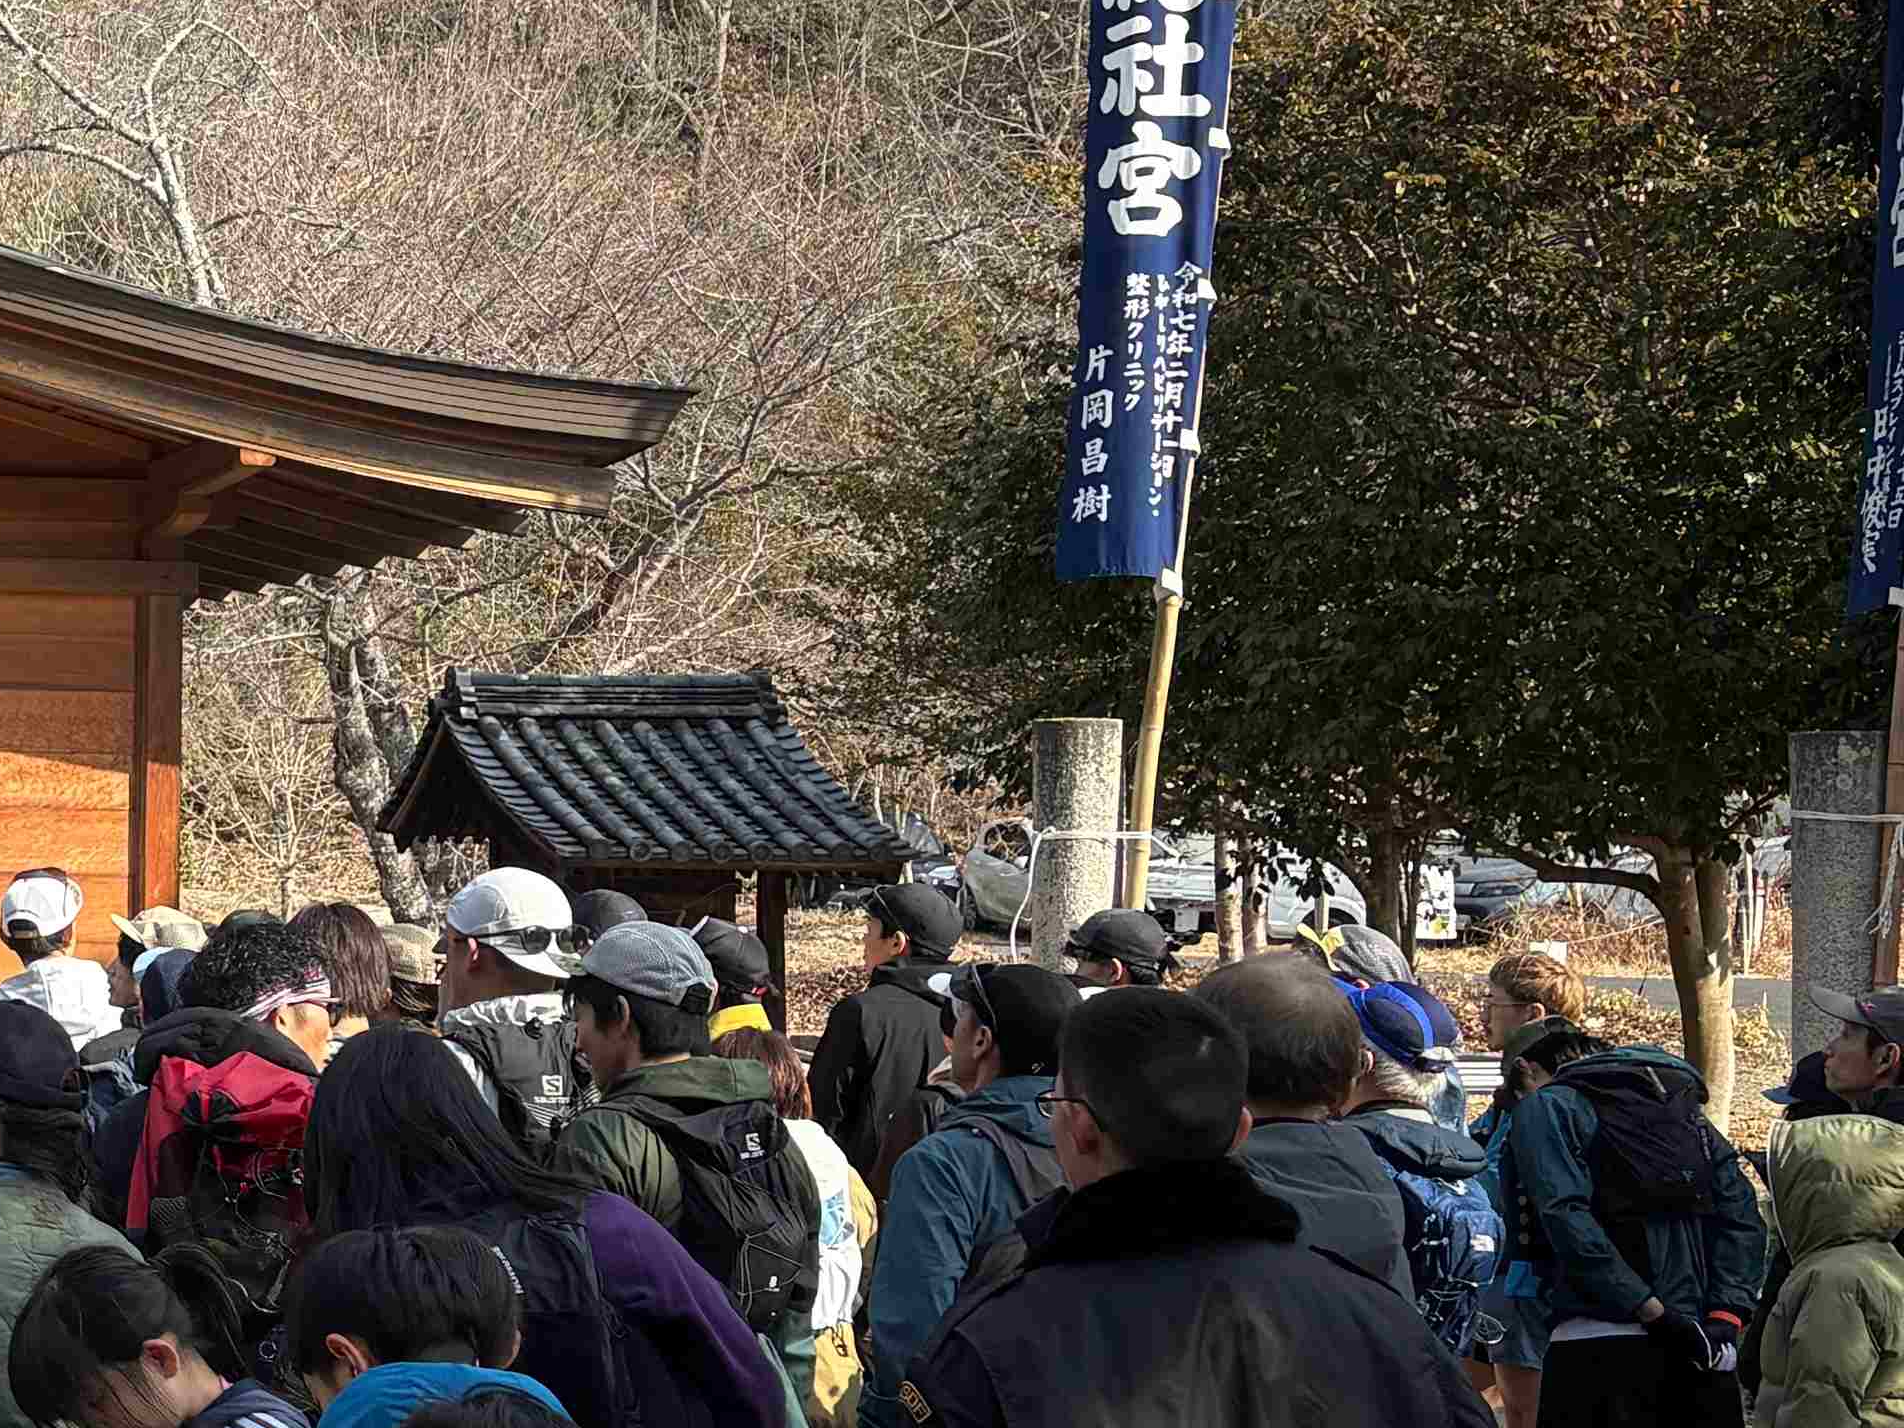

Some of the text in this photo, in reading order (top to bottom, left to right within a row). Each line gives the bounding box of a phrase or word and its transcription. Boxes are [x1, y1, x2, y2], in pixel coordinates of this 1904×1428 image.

[1123, 272, 1151, 412] 整形クリニック
[1072, 344, 1115, 524] 片岡昌樹
